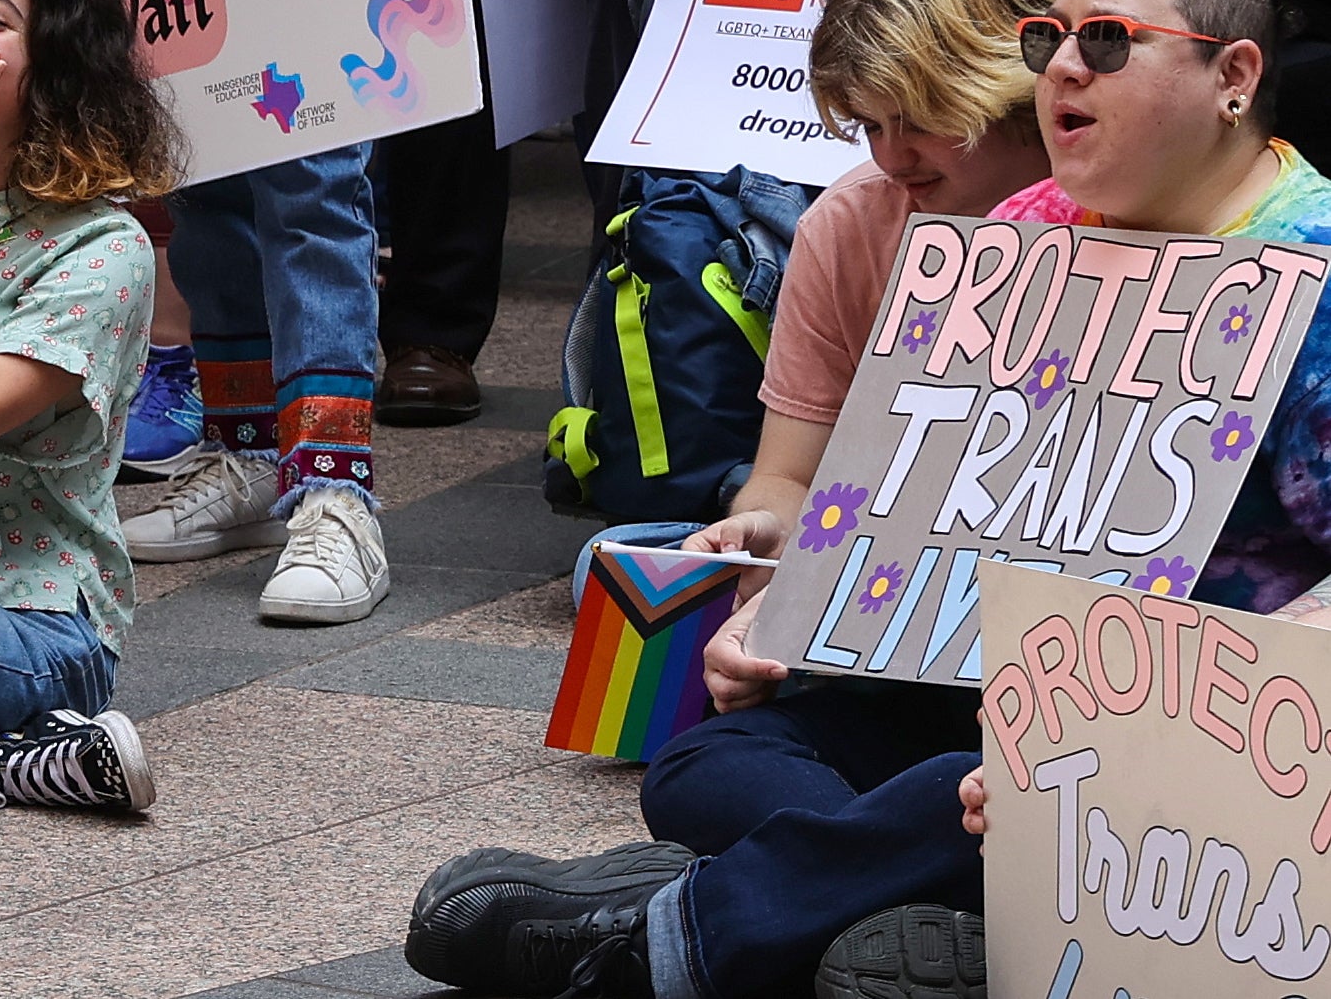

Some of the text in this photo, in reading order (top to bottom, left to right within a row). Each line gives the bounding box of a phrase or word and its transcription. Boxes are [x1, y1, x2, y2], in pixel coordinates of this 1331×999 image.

[717, 21, 769, 37] LGBTQ+
[204, 73, 260, 96] TRANSGENDER
[215, 83, 262, 103] EDUCATION
[296, 102, 336, 120] NETWORK
[297, 112, 336, 130] OF TEXAS
[871, 221, 1329, 401] PROTECT
[869, 382, 1220, 556] TRANS
[982, 594, 1331, 853] PROTEC
[1033, 748, 1331, 980] Trans
